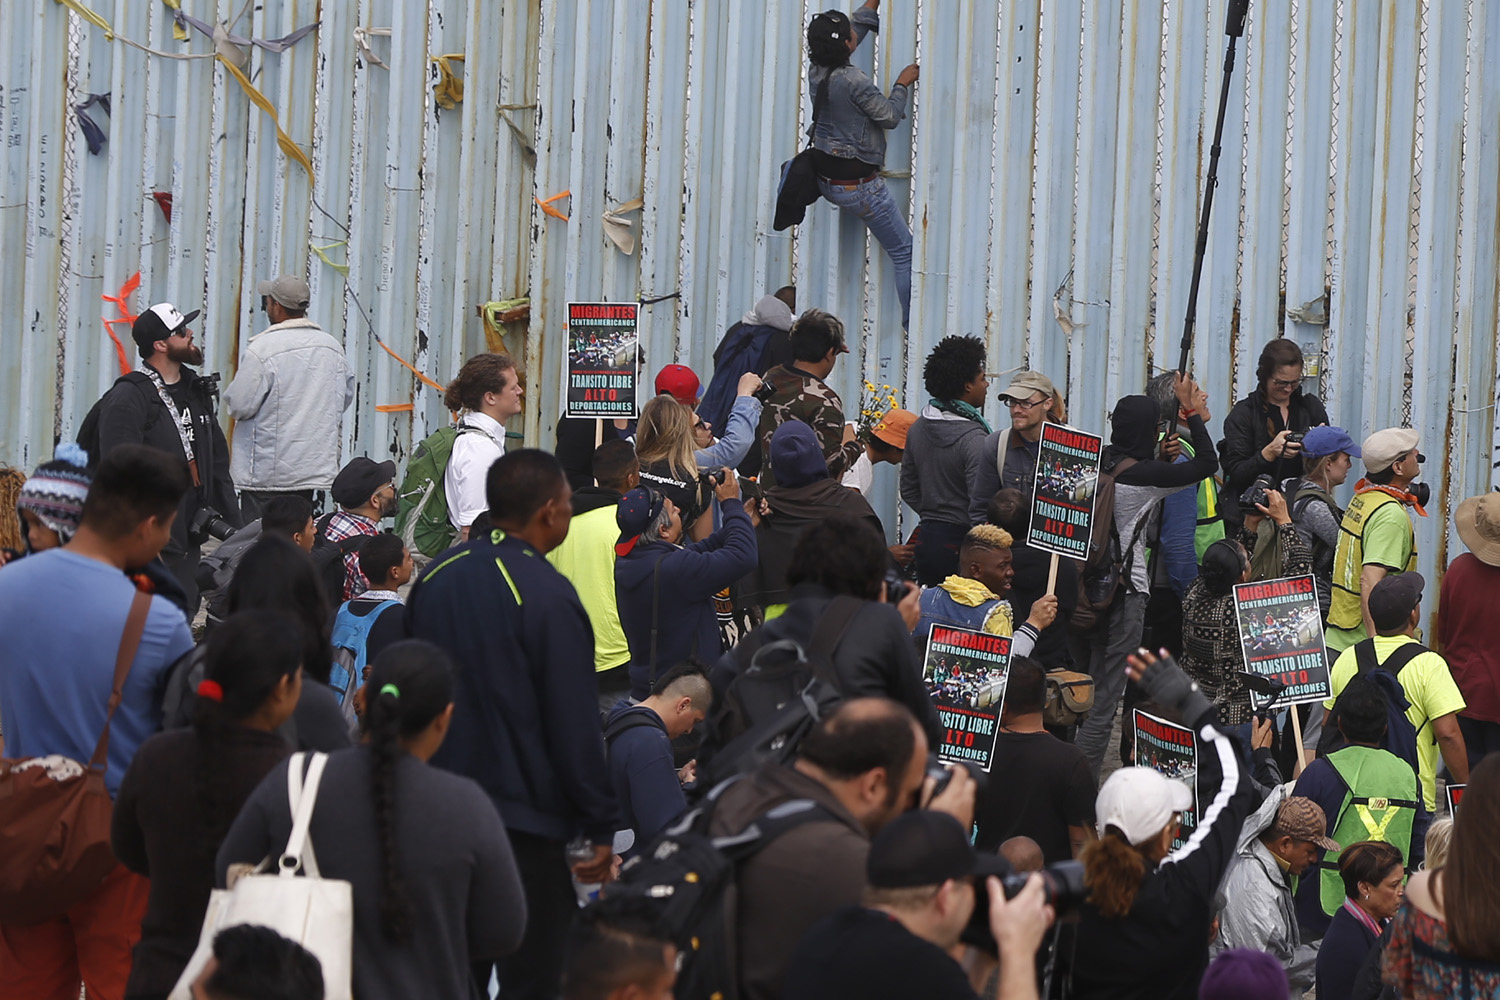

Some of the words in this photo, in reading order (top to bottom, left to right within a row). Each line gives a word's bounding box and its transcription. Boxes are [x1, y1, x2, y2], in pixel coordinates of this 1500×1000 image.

[570, 305, 635, 319] MIGRANTES
[570, 318, 635, 327] CENTROAMERICANOS
[571, 374, 607, 388] TRANSITO
[609, 374, 632, 388] LIBRE
[584, 388, 617, 401] ALTO
[569, 401, 632, 411] DEPORTACIONES
[1043, 426, 1099, 453] MIGRANTES
[1042, 440, 1098, 461] CENTROAMERICANOS
[1035, 500, 1066, 521] TRANSITO
[1067, 508, 1089, 527] LIBRE
[1044, 519, 1074, 537] ALTO
[1031, 528, 1086, 551] DEPORTACIONES
[1237, 578, 1313, 602] MIGRANTES
[1239, 592, 1314, 610] CENTROAMERICANOS
[932, 627, 1009, 655] MIGRANTES
[931, 642, 1007, 664] CENTROAMERICANOS
[1250, 657, 1296, 675] TRANSITO
[1298, 653, 1323, 671] LIBRE
[967, 715, 994, 736] LIBRE
[1136, 714, 1193, 748] MIGRANTES
[946, 729, 975, 748] LTO
[1137, 729, 1194, 756] CENTROAMERICANOS
